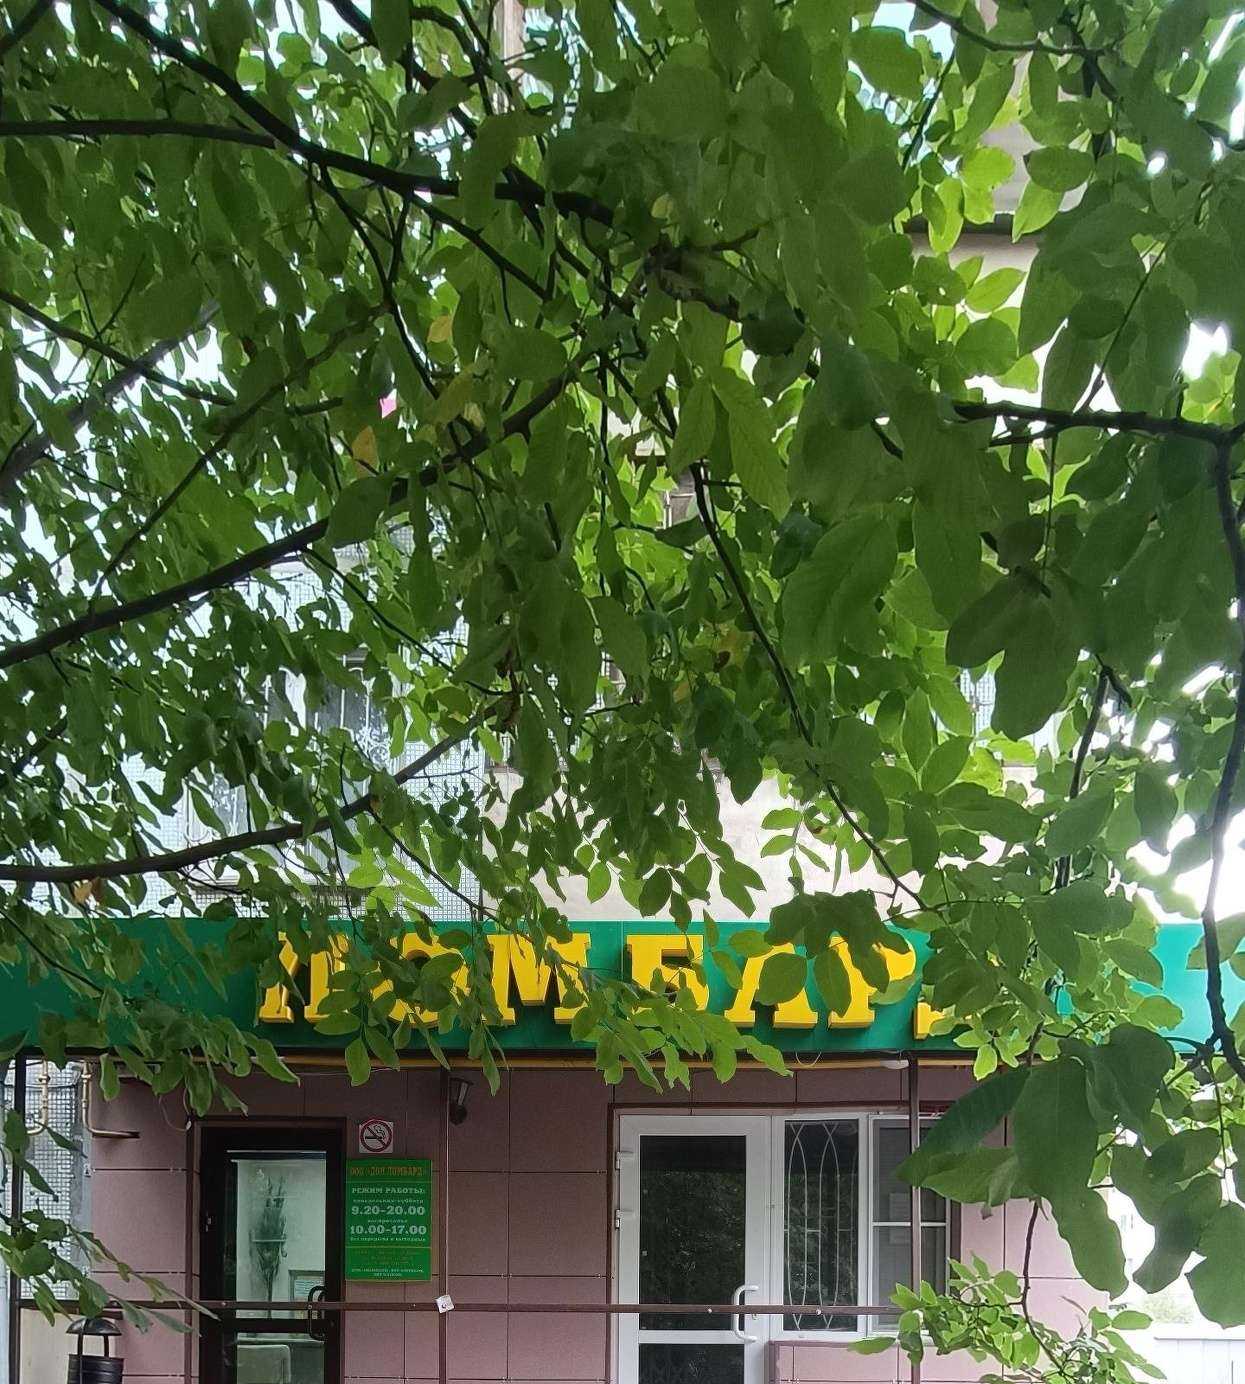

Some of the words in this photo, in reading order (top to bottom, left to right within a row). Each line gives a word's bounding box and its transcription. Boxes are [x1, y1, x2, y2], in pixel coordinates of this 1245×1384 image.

[258, 931, 972, 1039] ЛОМБАР
[351, 1206, 426, 1215] 9.20-20.00
[350, 1225, 427, 1235] 10.00-17.00
